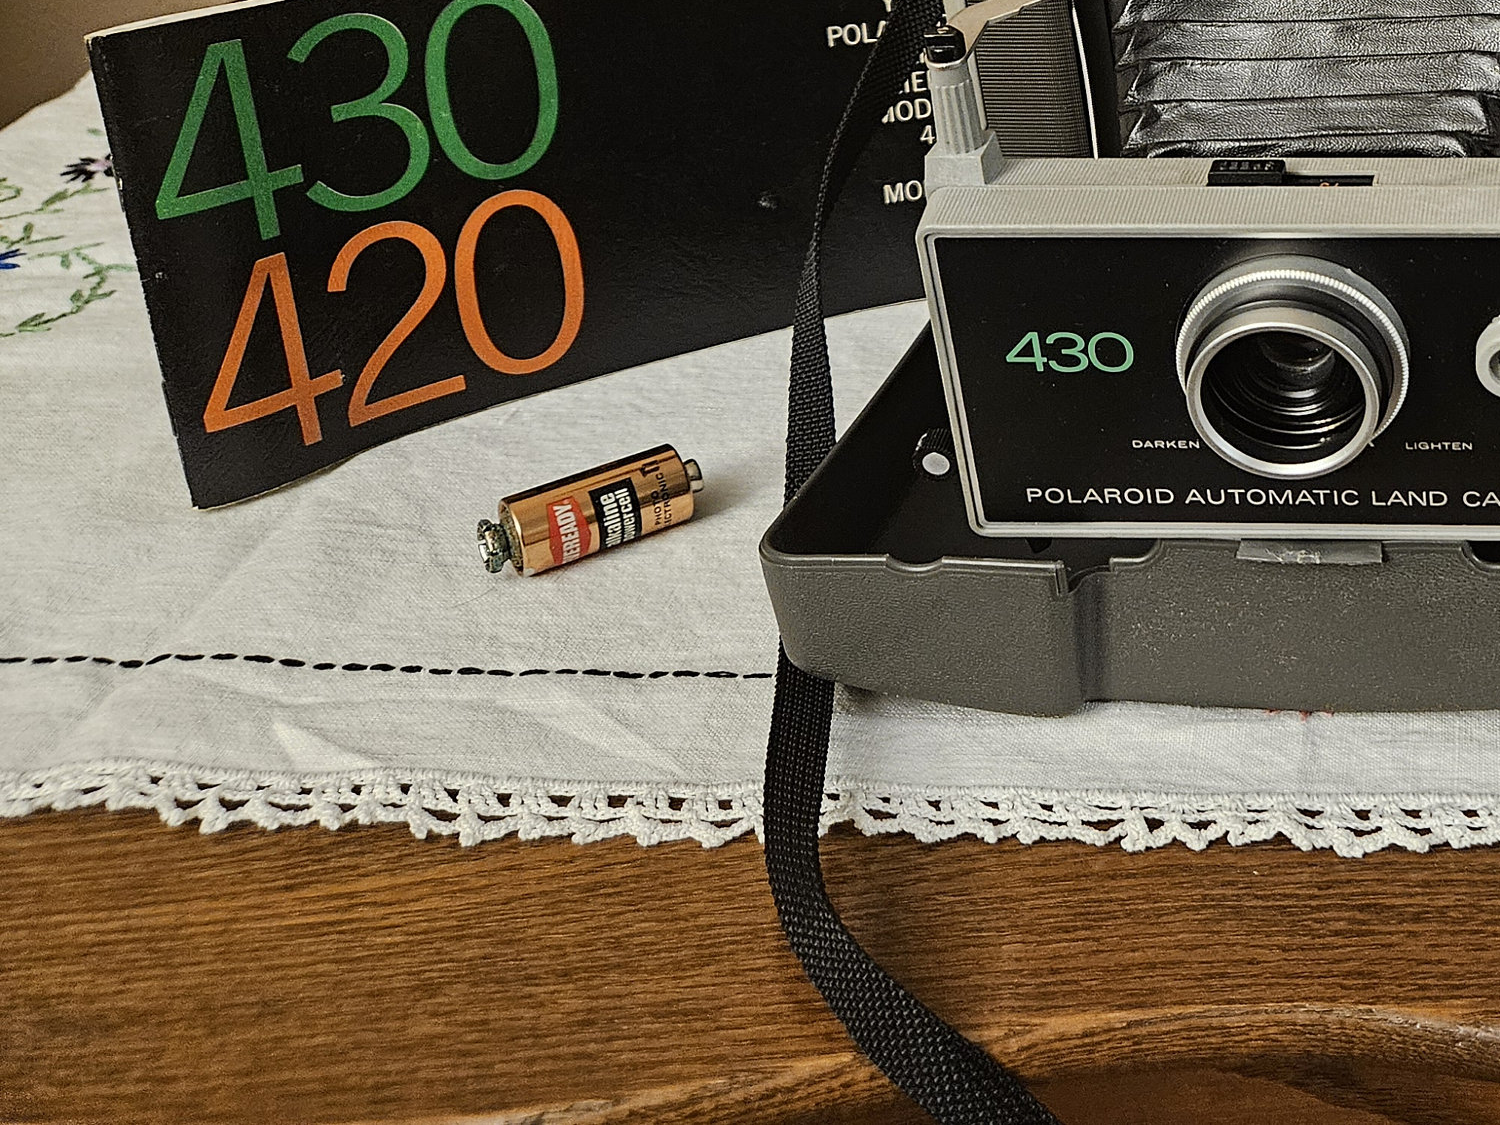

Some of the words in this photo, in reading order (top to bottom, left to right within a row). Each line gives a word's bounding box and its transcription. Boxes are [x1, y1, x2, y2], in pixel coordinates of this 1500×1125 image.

[202, 189, 586, 447] 420
[1005, 332, 1134, 373] 430
[1132, 440, 1200, 449] DARKEN
[1405, 441, 1473, 451] LIGHTEN
[651, 489, 661, 526] PHOTO
[1026, 486, 1175, 507] POLAROID
[1185, 487, 1360, 507] AUTOMATIC
[1371, 488, 1446, 509] LAND
[552, 500, 580, 565] VEREADY
[600, 491, 623, 549] alkaline
